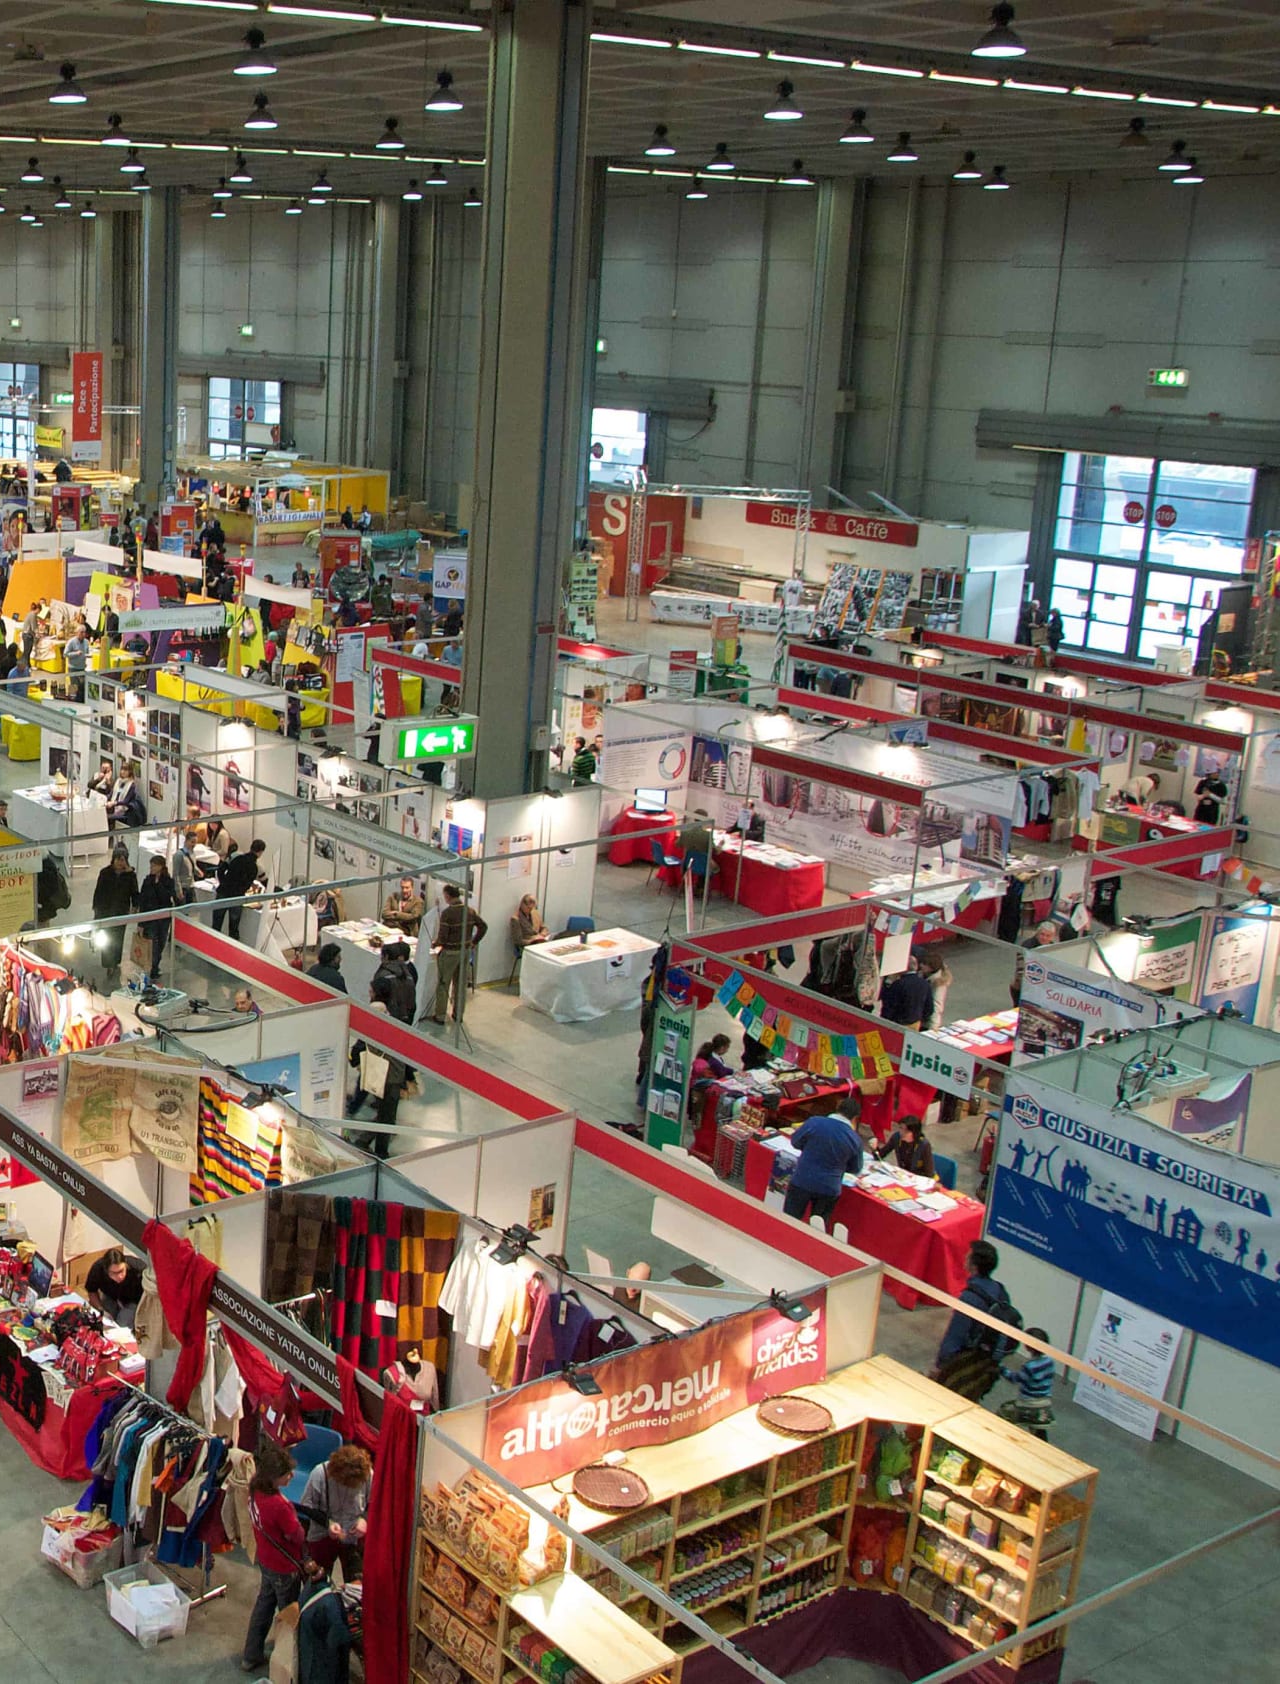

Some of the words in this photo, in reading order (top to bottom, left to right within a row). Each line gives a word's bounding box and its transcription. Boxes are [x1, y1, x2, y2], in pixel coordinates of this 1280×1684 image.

[78, 389, 87, 413] Pace
[89, 360, 99, 433] Partecipazione
[1125, 507, 1144, 518] STOP
[1156, 511, 1176, 521] STOP
[845, 518, 889, 541] Caffè
[434, 580, 451, 589] GAP
[1045, 988, 1103, 1017] SOLIDARIA
[659, 1014, 691, 1040] enaip
[905, 1044, 953, 1077] ipsia
[1044, 1111, 1133, 1162] GIUSTIZIA
[1138, 1153, 1150, 1168] E
[26, 1141, 36, 1157] YA
[63, 1169, 86, 1196] ONLUS
[211, 1285, 276, 1342] ASSOCIAZIONE
[276, 1333, 307, 1365] YATRA
[307, 1358, 341, 1389] ONLUS
[607, 1415, 670, 1438] commercio
[670, 1407, 696, 1424] equo
[704, 1387, 731, 1411] solidale
